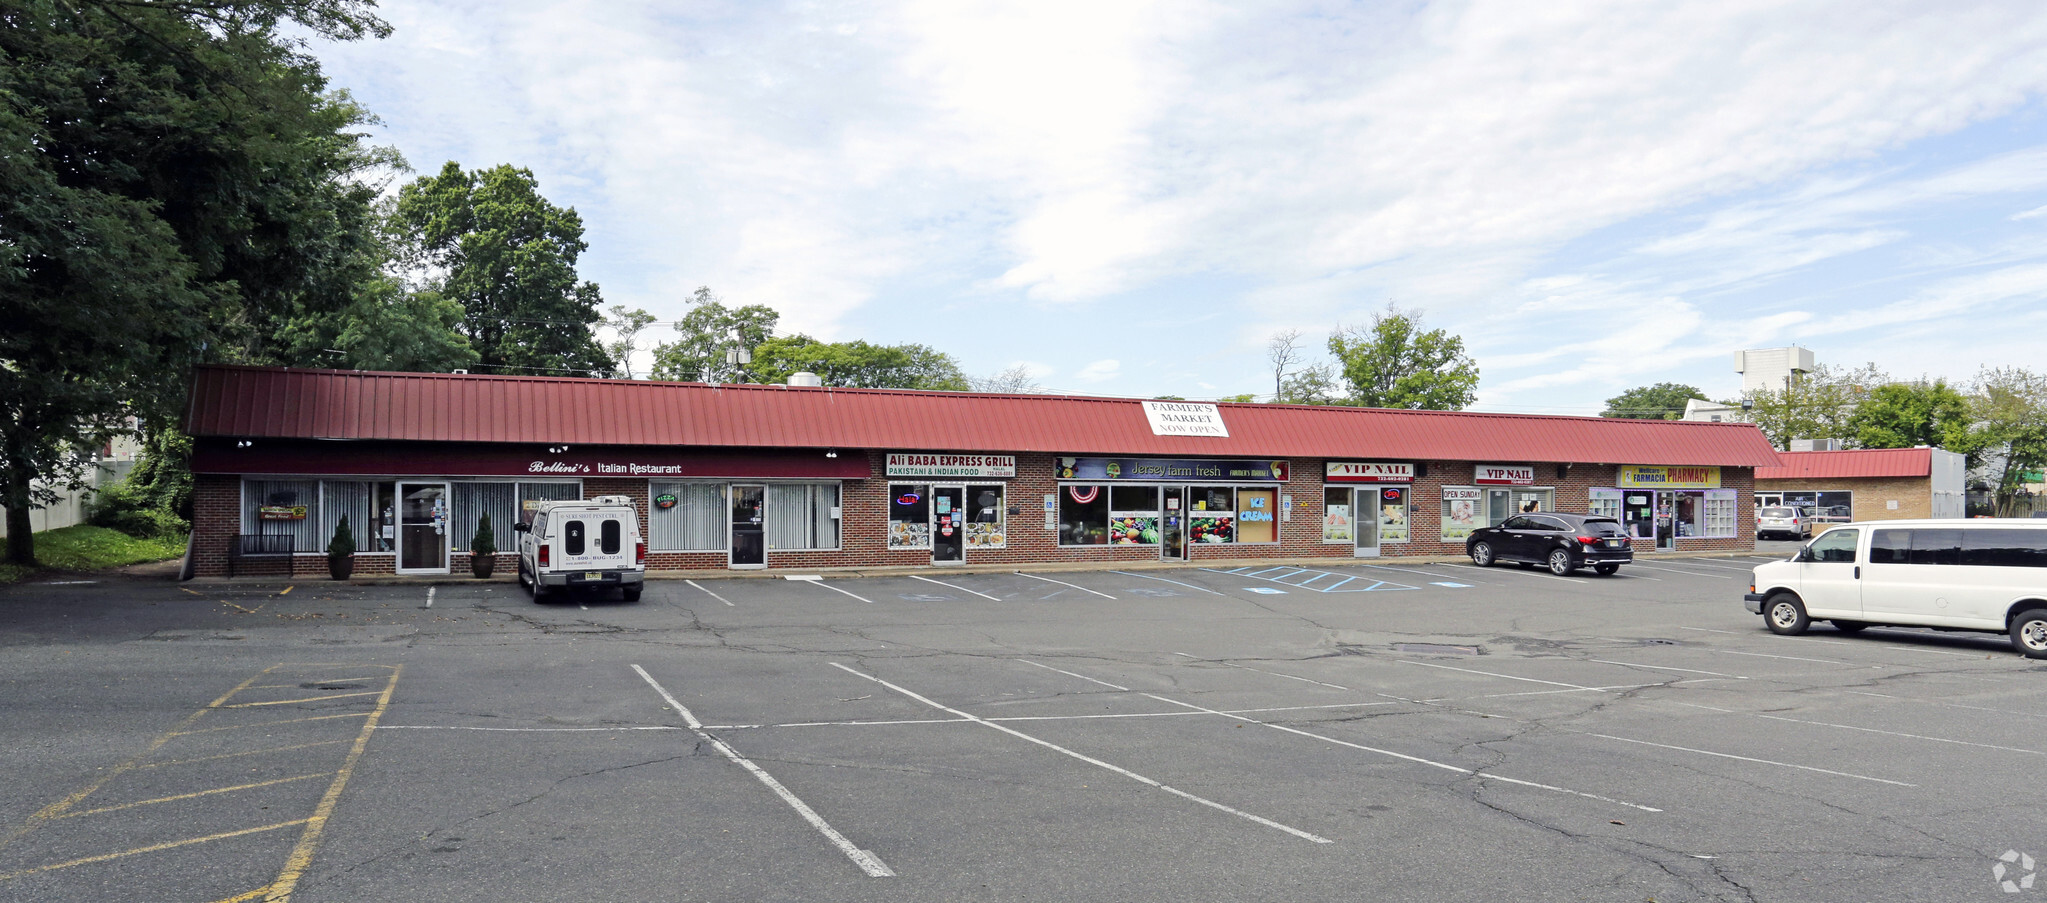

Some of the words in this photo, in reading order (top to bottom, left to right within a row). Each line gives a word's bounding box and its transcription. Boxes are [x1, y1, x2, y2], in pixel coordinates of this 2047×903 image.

[1151, 402, 1213, 412] FARMER'S
[1161, 413, 1212, 423] MARKET
[1160, 424, 1187, 433] NOW
[1189, 425, 1220, 433] OPEN
[889, 455, 905, 466] Ali
[907, 456, 937, 466] BABA
[940, 456, 982, 467] EXPRESS
[985, 457, 1013, 467] GRILL
[528, 461, 590, 473] Bellini's
[597, 462, 627, 473] Italian
[629, 463, 682, 475] Restaurant
[889, 467, 926, 475] PAKISTANI
[960, 468, 979, 476] FOOD
[1131, 462, 1166, 477] Jersey
[1167, 465, 1192, 476] farm
[1196, 465, 1221, 477] fresh
[1344, 465, 1370, 474] VIP
[1375, 465, 1409, 475] NAIL
[1487, 469, 1505, 479] VIP
[1507, 470, 1531, 479] NAIL
[1633, 474, 1666, 482] FARMACIA
[1667, 467, 1710, 483] PHARMACY
[1384, 490, 1400, 498] OPEN
[1250, 497, 1265, 508] ICE
[1240, 510, 1273, 522] CREAM
